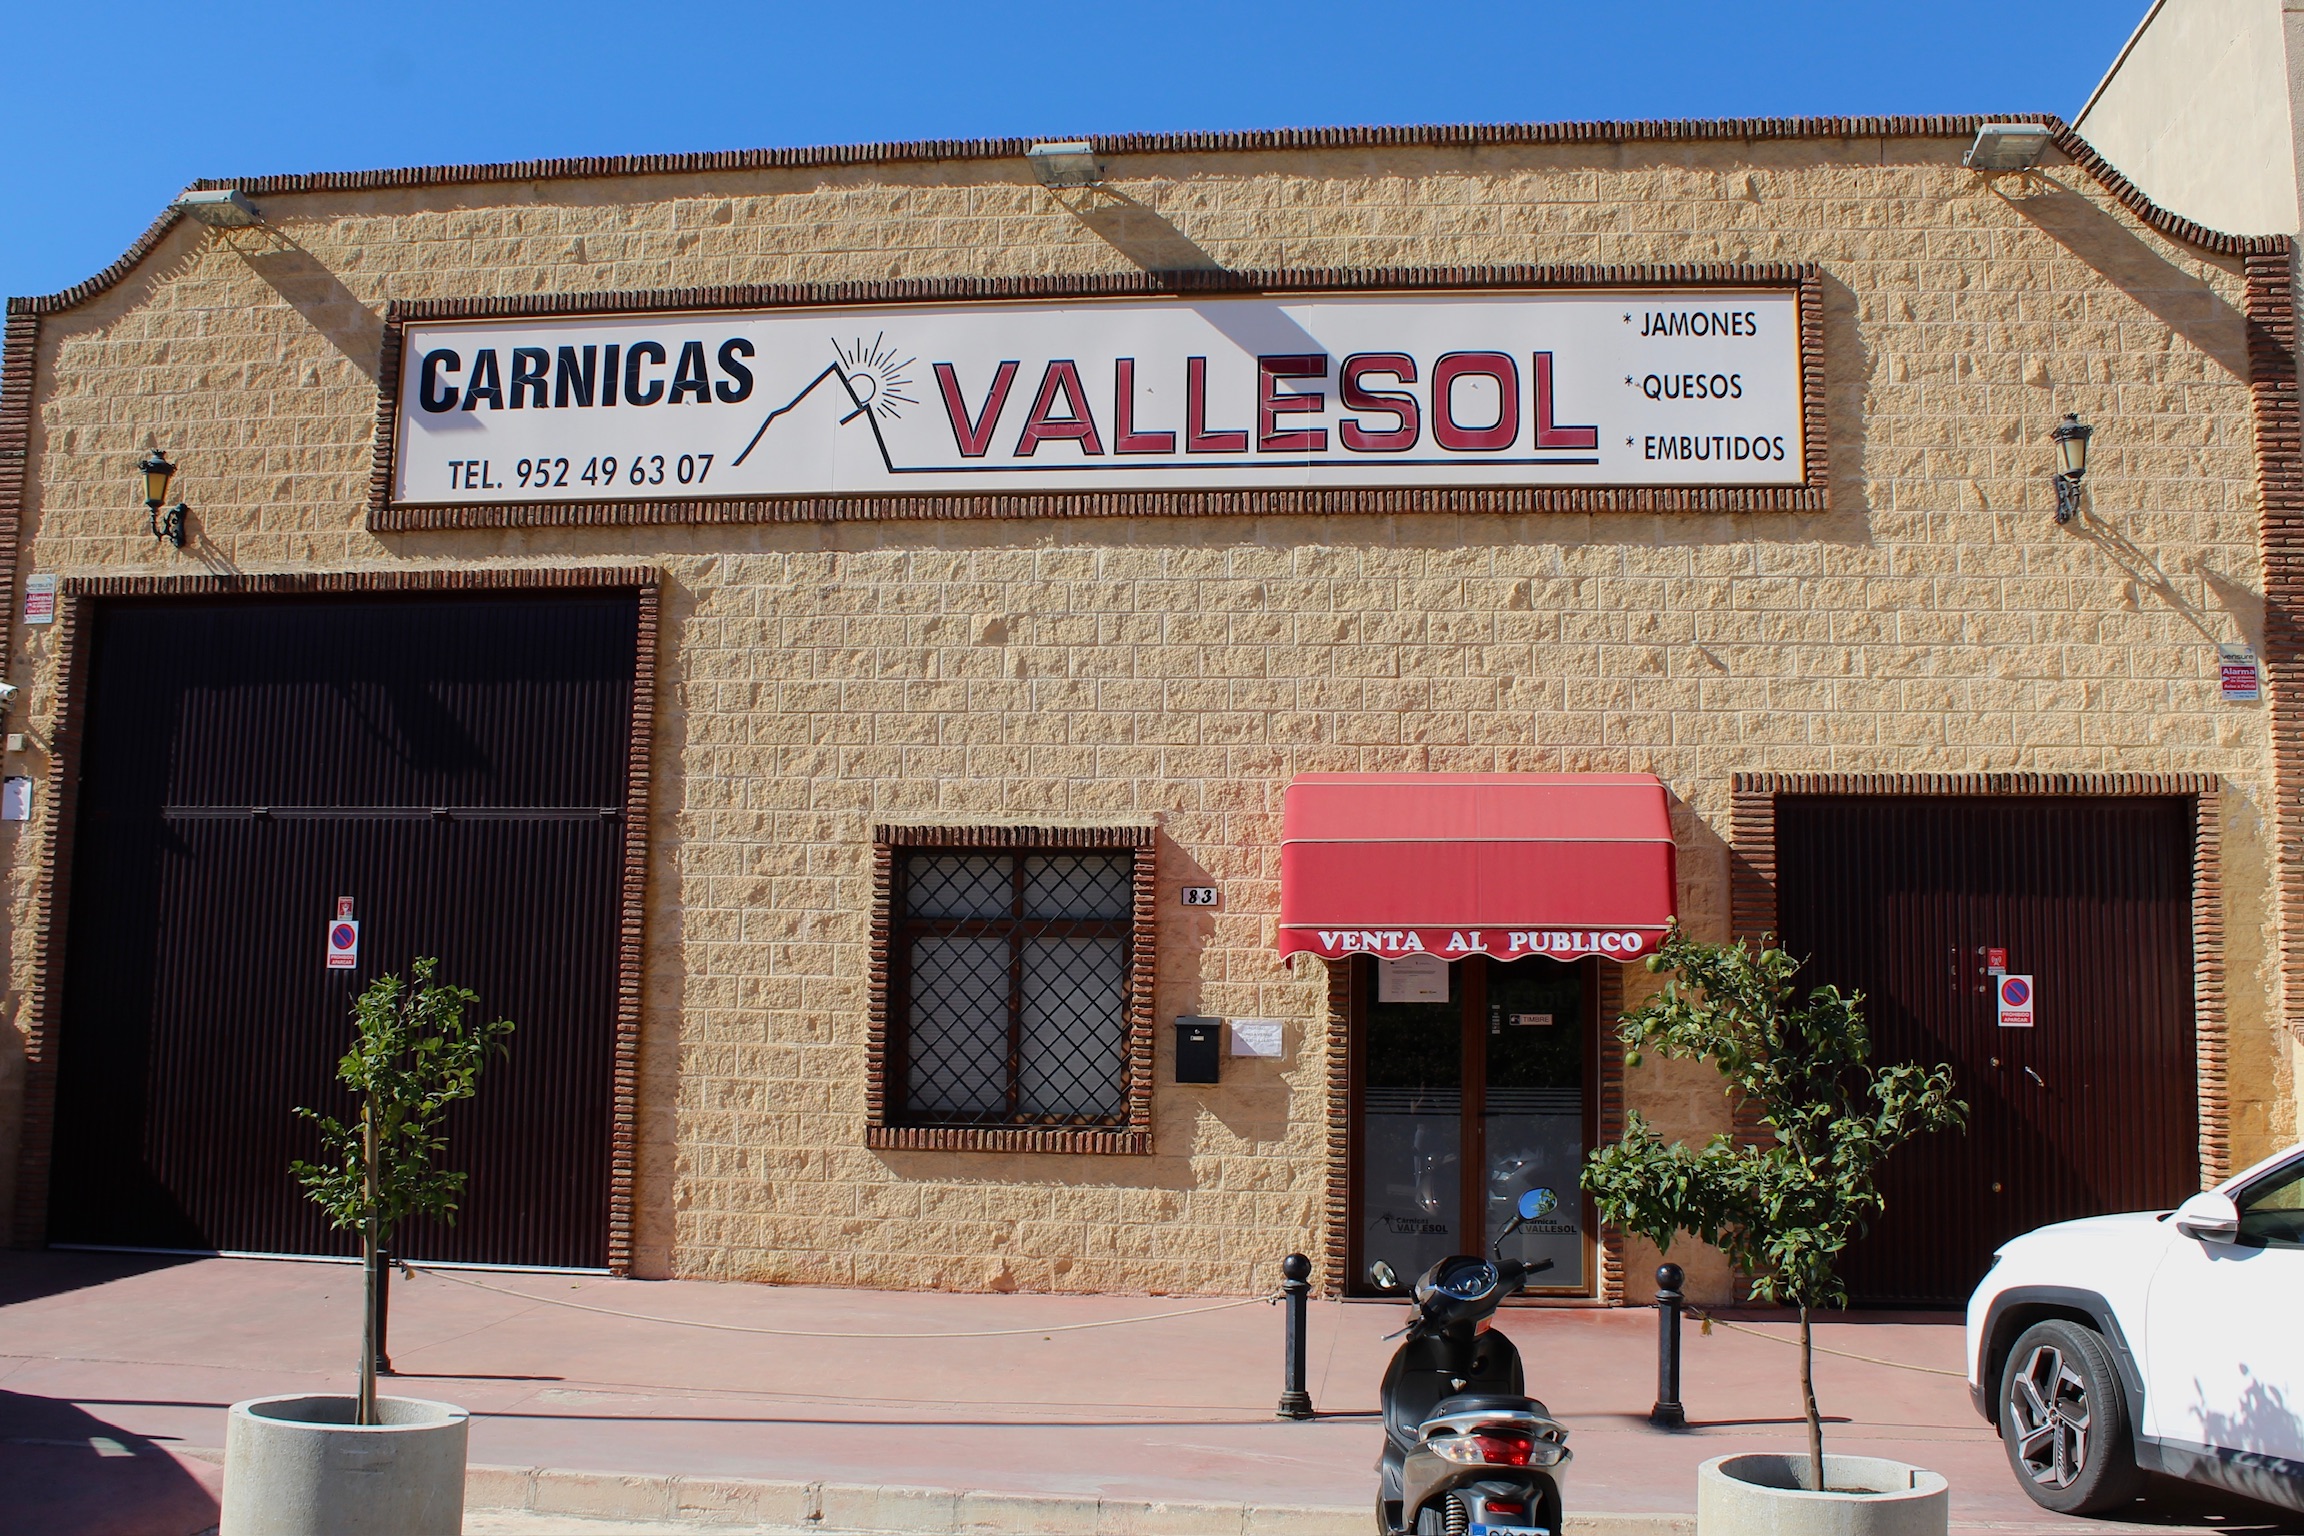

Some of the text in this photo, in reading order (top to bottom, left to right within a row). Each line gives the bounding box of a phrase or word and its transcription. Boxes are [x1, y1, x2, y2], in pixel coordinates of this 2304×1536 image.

[1640, 312, 1757, 337] JAMONES
[419, 338, 755, 413] CARNICAS
[1643, 374, 1742, 401] QUESOS
[932, 350, 1600, 458] VALLESOL
[1644, 436, 1785, 461] EMBUTIDOS
[448, 454, 715, 490] TEL. 952 49 63 07
[1188, 889, 1213, 904] 83
[1317, 930, 1644, 953] VENTA AL PUBLICO
[1397, 1224, 1449, 1233] VALLESOL
[1526, 1225, 1577, 1233] VALLESOL
